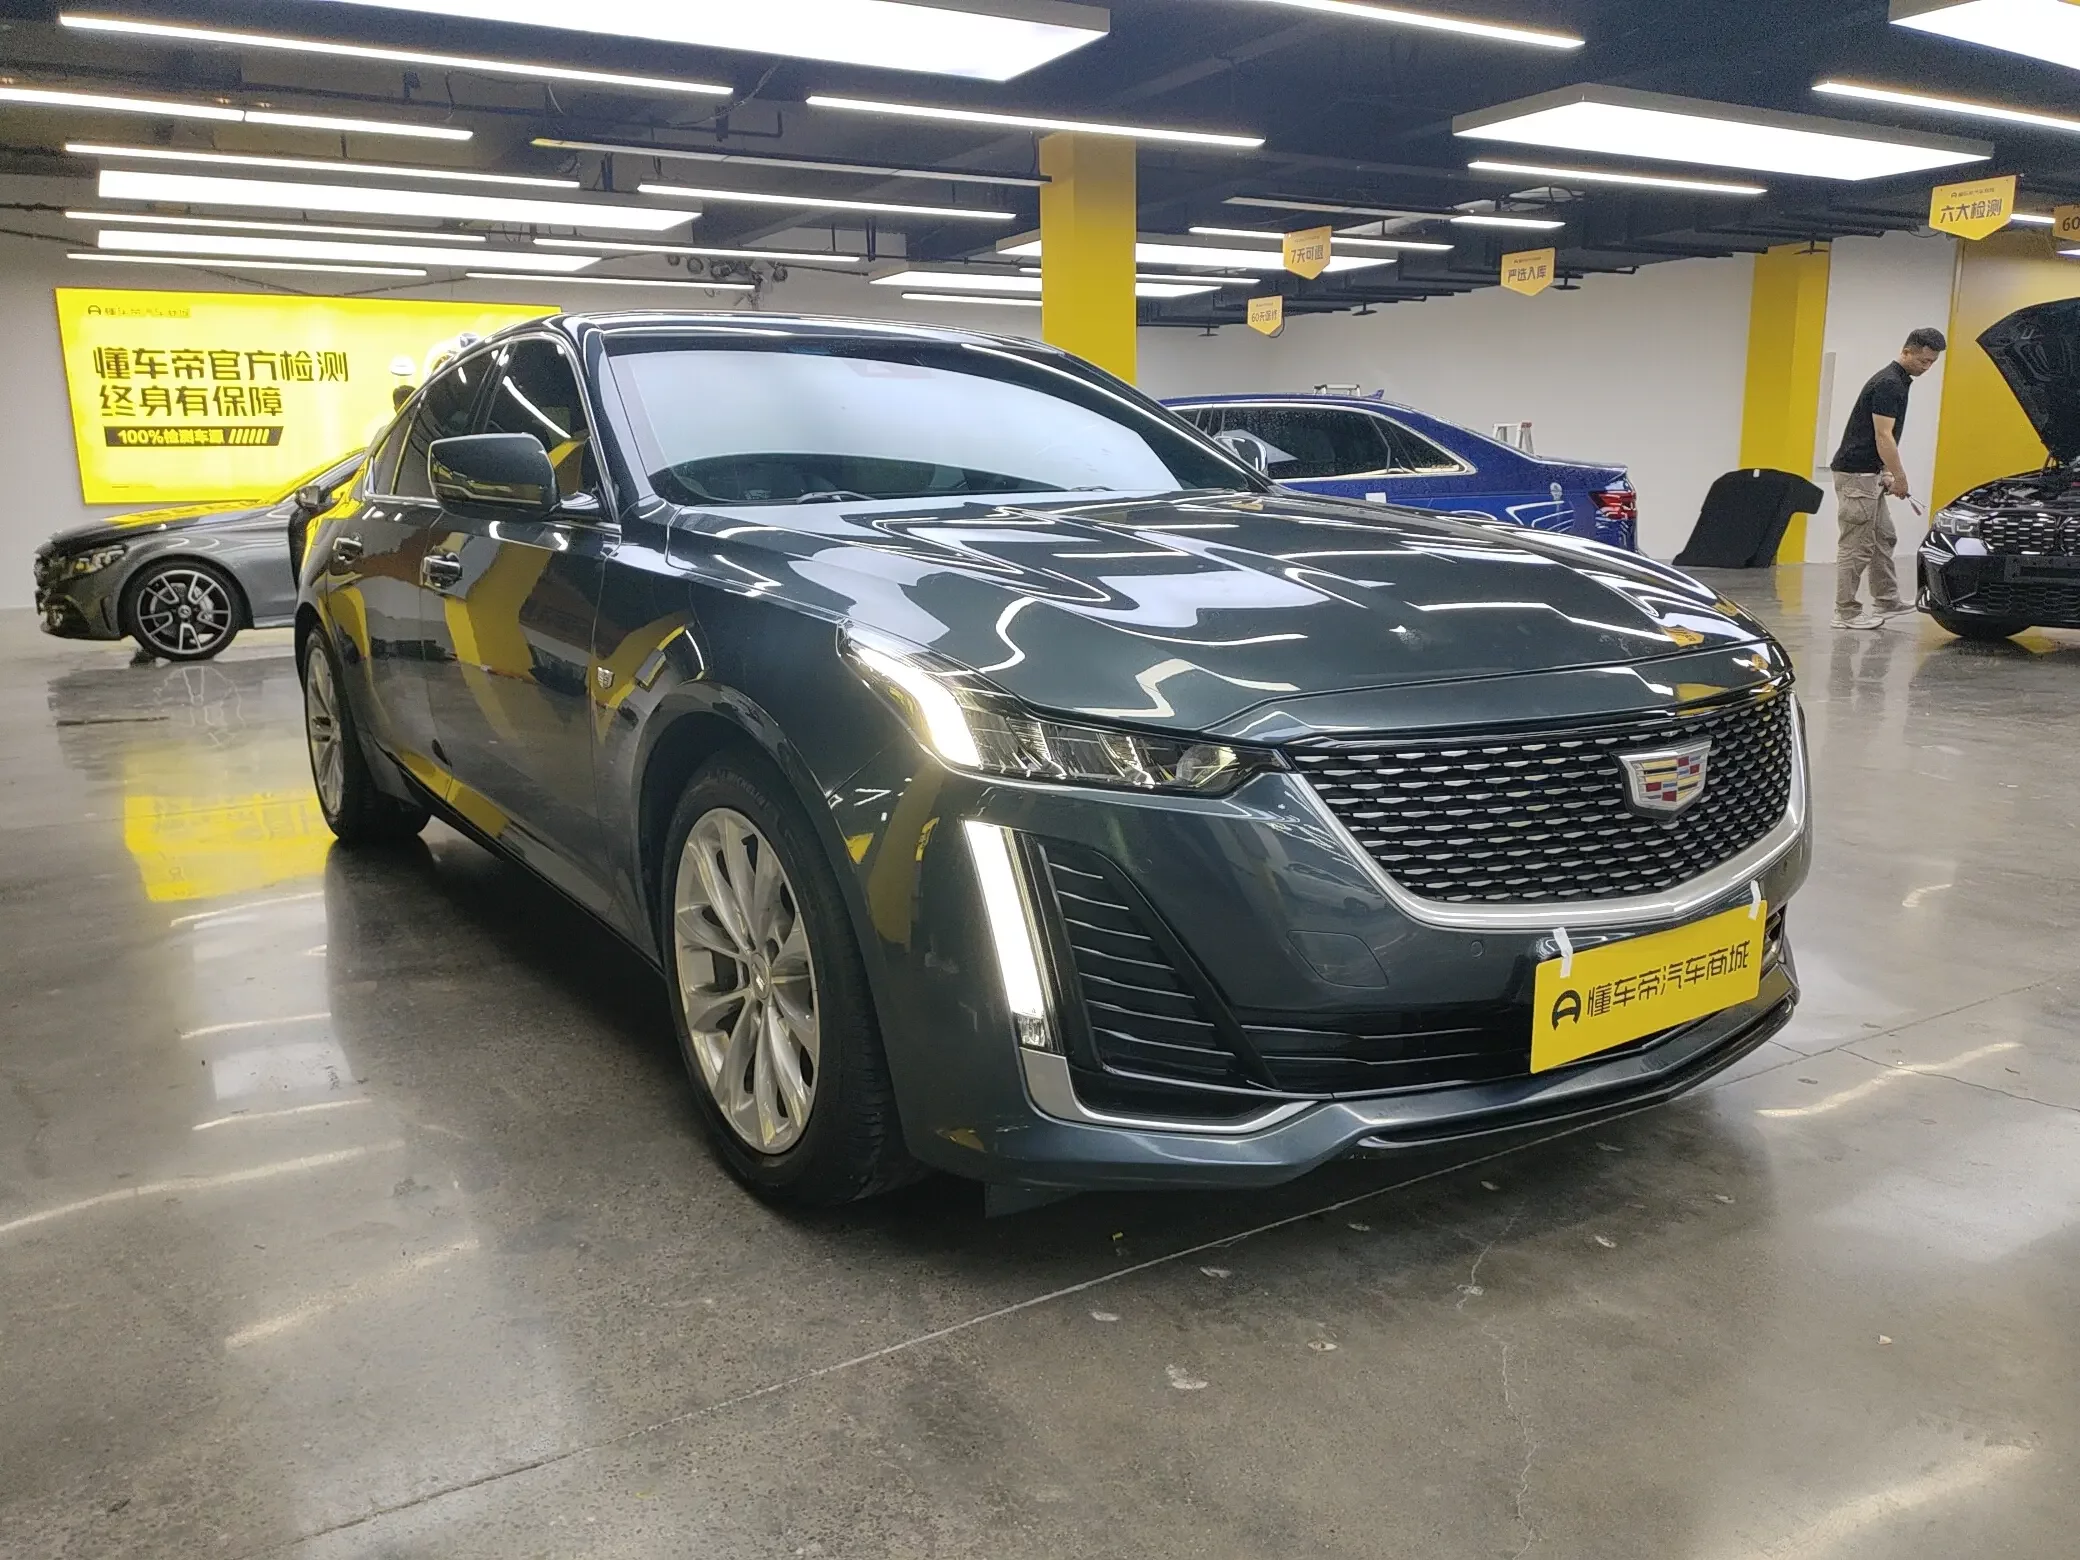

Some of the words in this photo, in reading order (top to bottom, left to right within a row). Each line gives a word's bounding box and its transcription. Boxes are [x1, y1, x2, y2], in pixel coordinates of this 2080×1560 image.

[1940, 198, 2002, 223] 六大检测
[1507, 265, 1548, 283] 严选入库
[93, 346, 350, 383] 懂车帝官方检测
[97, 384, 285, 417] 终身有保障
[1585, 939, 1751, 1017] 懂车帝汽车商城
